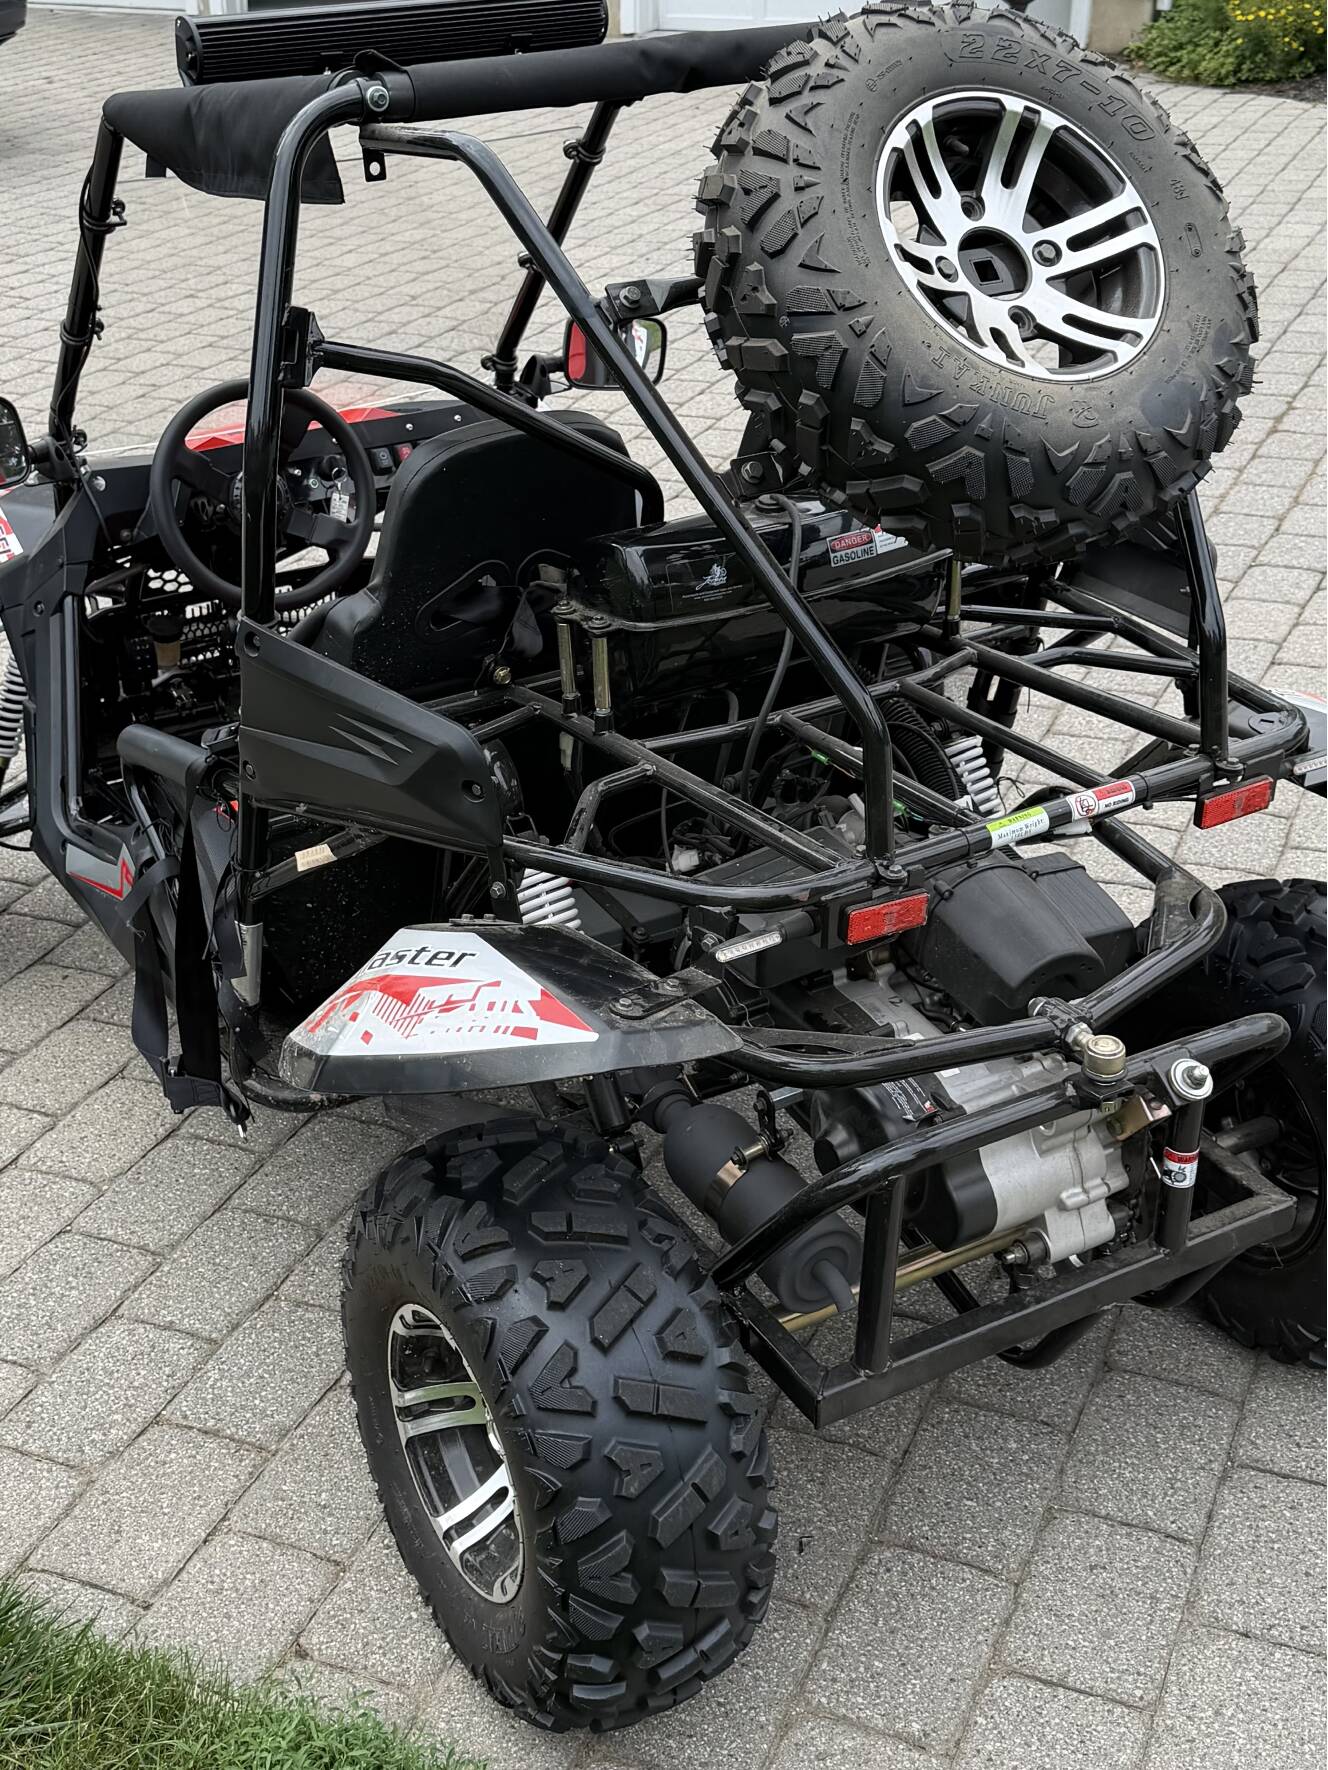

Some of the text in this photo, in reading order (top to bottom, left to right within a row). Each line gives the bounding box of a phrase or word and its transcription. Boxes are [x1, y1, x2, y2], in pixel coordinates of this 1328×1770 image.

[834, 533, 869, 549] DANGER
[832, 545, 876, 565] GASOLINE
[365, 946, 478, 971] aster
